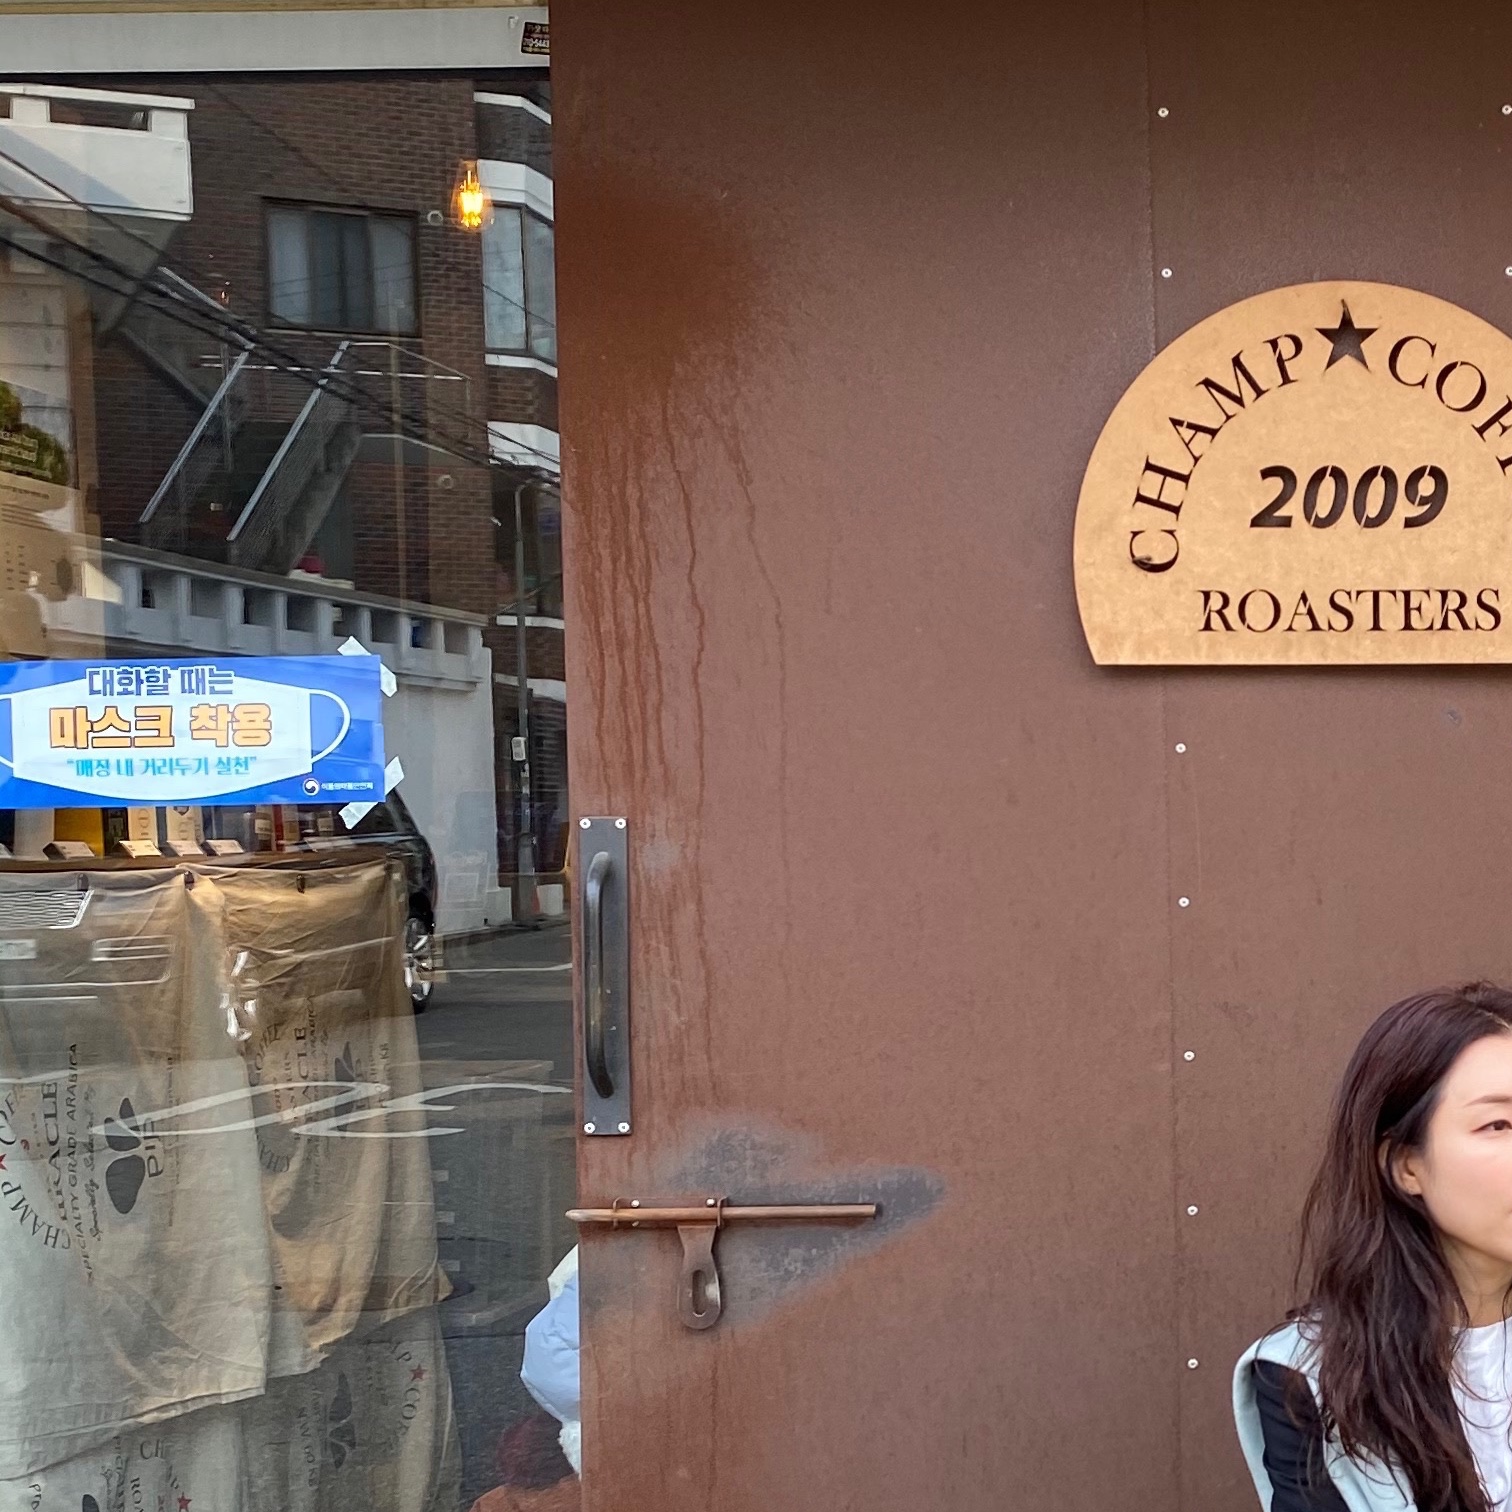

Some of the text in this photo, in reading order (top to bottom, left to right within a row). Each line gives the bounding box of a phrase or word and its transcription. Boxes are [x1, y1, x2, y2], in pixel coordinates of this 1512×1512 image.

[1129, 332, 1305, 574] CHAMP
[1249, 464, 1449, 529] 2009
[1199, 587, 1502, 633] ROASTERS
[87, 666, 235, 697] 대화할 때는
[49, 702, 273, 750] 마스크 착용
[117, 758, 134, 777] 내
[140, 757, 208, 776] 거리두기
[1, 1180, 71, 1250] CHAMP
